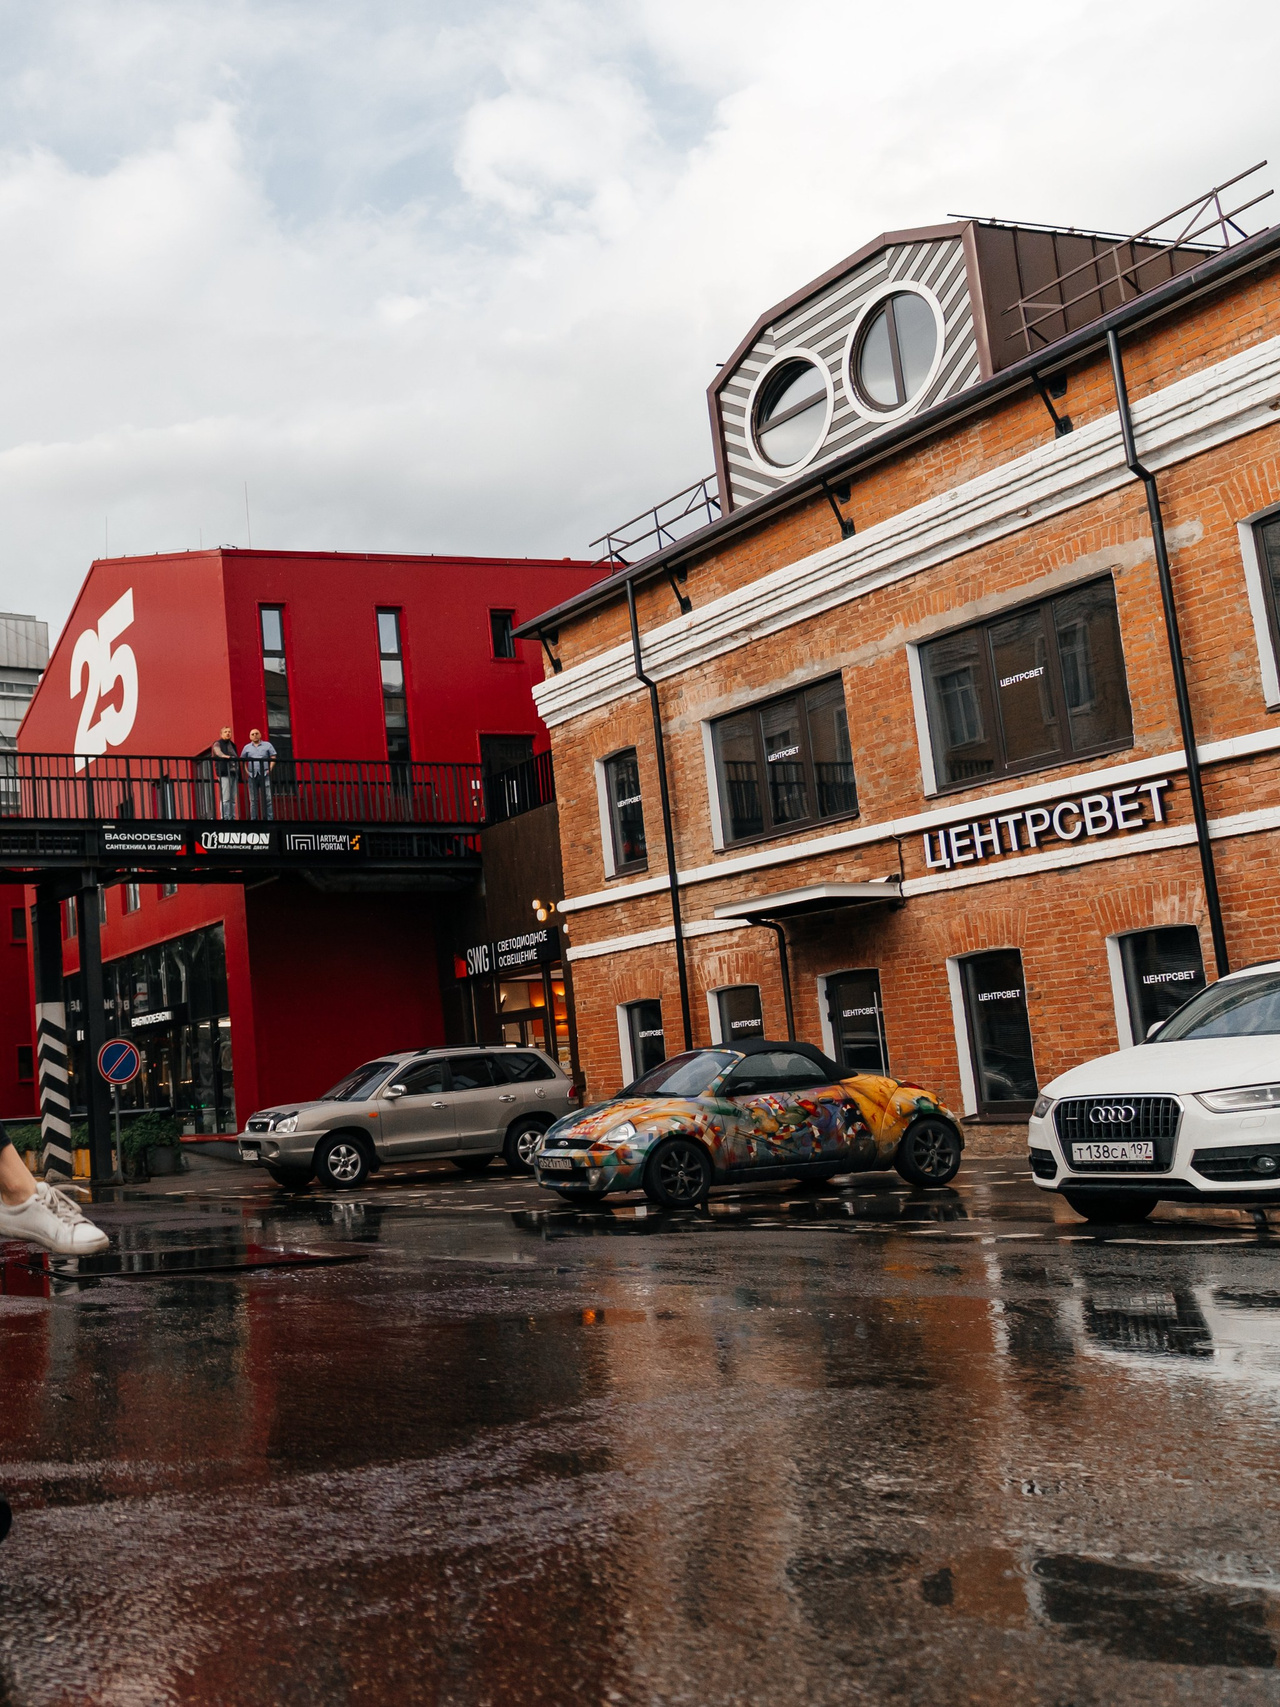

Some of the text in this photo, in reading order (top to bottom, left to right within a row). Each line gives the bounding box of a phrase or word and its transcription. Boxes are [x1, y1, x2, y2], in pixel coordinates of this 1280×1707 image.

[70, 586, 139, 774] 25
[999, 666, 1045, 688] ЦЕНТРСВЕТ
[923, 779, 1169, 869] ЦЕНТРСВЕТ
[104, 833, 182, 841] BAGNODESIGN
[218, 832, 270, 845] UNION
[320, 834, 347, 843] ARTPLAY
[105, 843, 147, 851] САНТЕХНИКА
[320, 843, 345, 851] PORTAL
[497, 929, 548, 953] СВЕТОДИОДНОЕ
[467, 944, 490, 976] SWG
[498, 948, 538, 968] ОСВЕЩЕНИЕ
[1142, 970, 1196, 985] ЦЕНТРСВЕТ
[977, 989, 1021, 1002] ЦЕНТРСВЕТ
[731, 1018, 762, 1029] ЦЕНТРСВЕТ
[1130, 1143, 1150, 1155] 197
